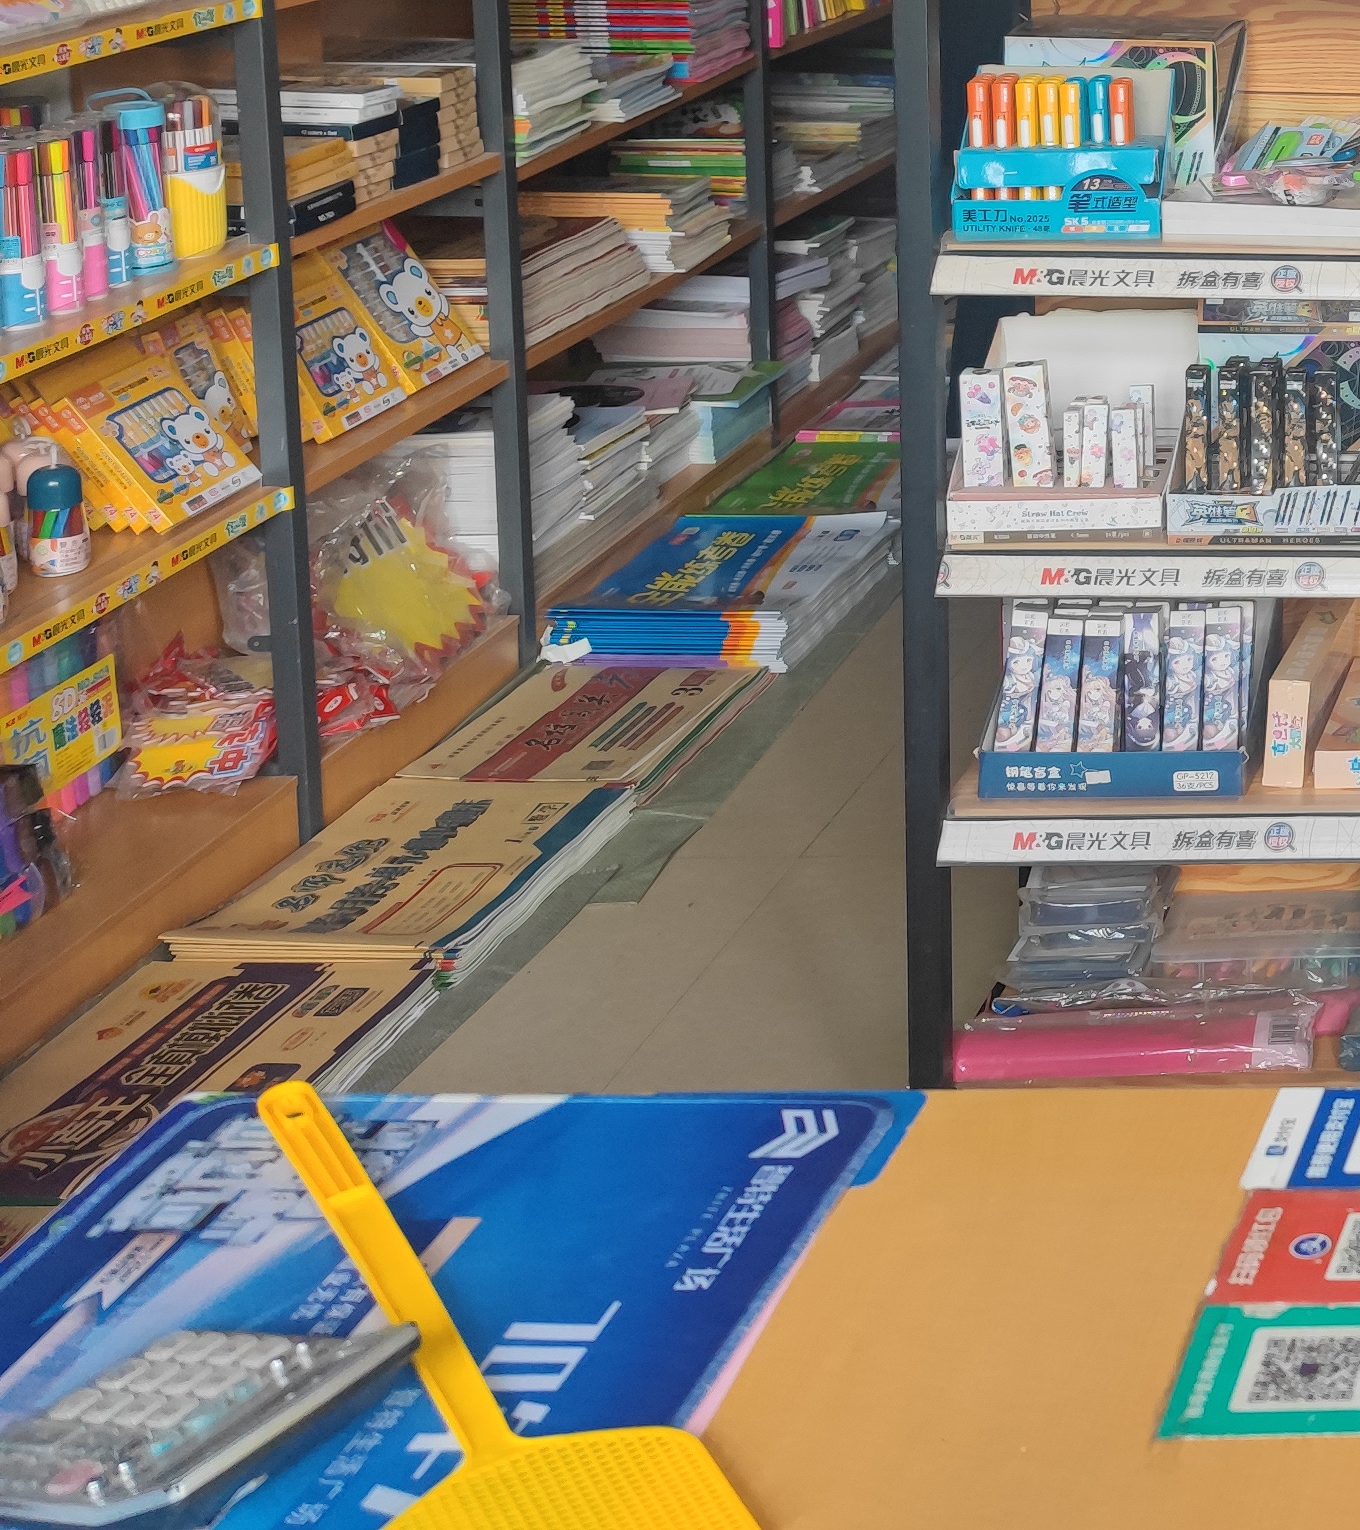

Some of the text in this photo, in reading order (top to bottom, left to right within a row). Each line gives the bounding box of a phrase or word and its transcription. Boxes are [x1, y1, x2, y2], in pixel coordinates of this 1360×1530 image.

[135, 17, 185, 41] M&G晨光文具
[1081, 178, 1101, 191] 13
[1067, 193, 1139, 213] 笔式造型
[961, 208, 1051, 224] 美工刀 No.2025
[962, 224, 1027, 233] UTILITY KNIFE
[1012, 266, 1265, 291] M&G晨光文具 拆盒有喜
[155, 279, 204, 310] M&G晨光文具
[14, 336, 70, 370] M&G晨光文具
[1021, 507, 1089, 518] Straw Hat Crew
[170, 532, 218, 569] M&G晨光文具
[1219, 536, 1273, 545] ULTRAMAN
[1040, 565, 1289, 588] M&G晨光文具 拆盒有喜
[31, 608, 87, 648] M&G晨光文具
[1004, 765, 1063, 780] 钢笔盲盒
[1175, 772, 1215, 781] GP-5212
[1005, 782, 1088, 793] 惊喜等着你来发现
[1011, 829, 1258, 852] M&G晨光文具 拆盒有喜
